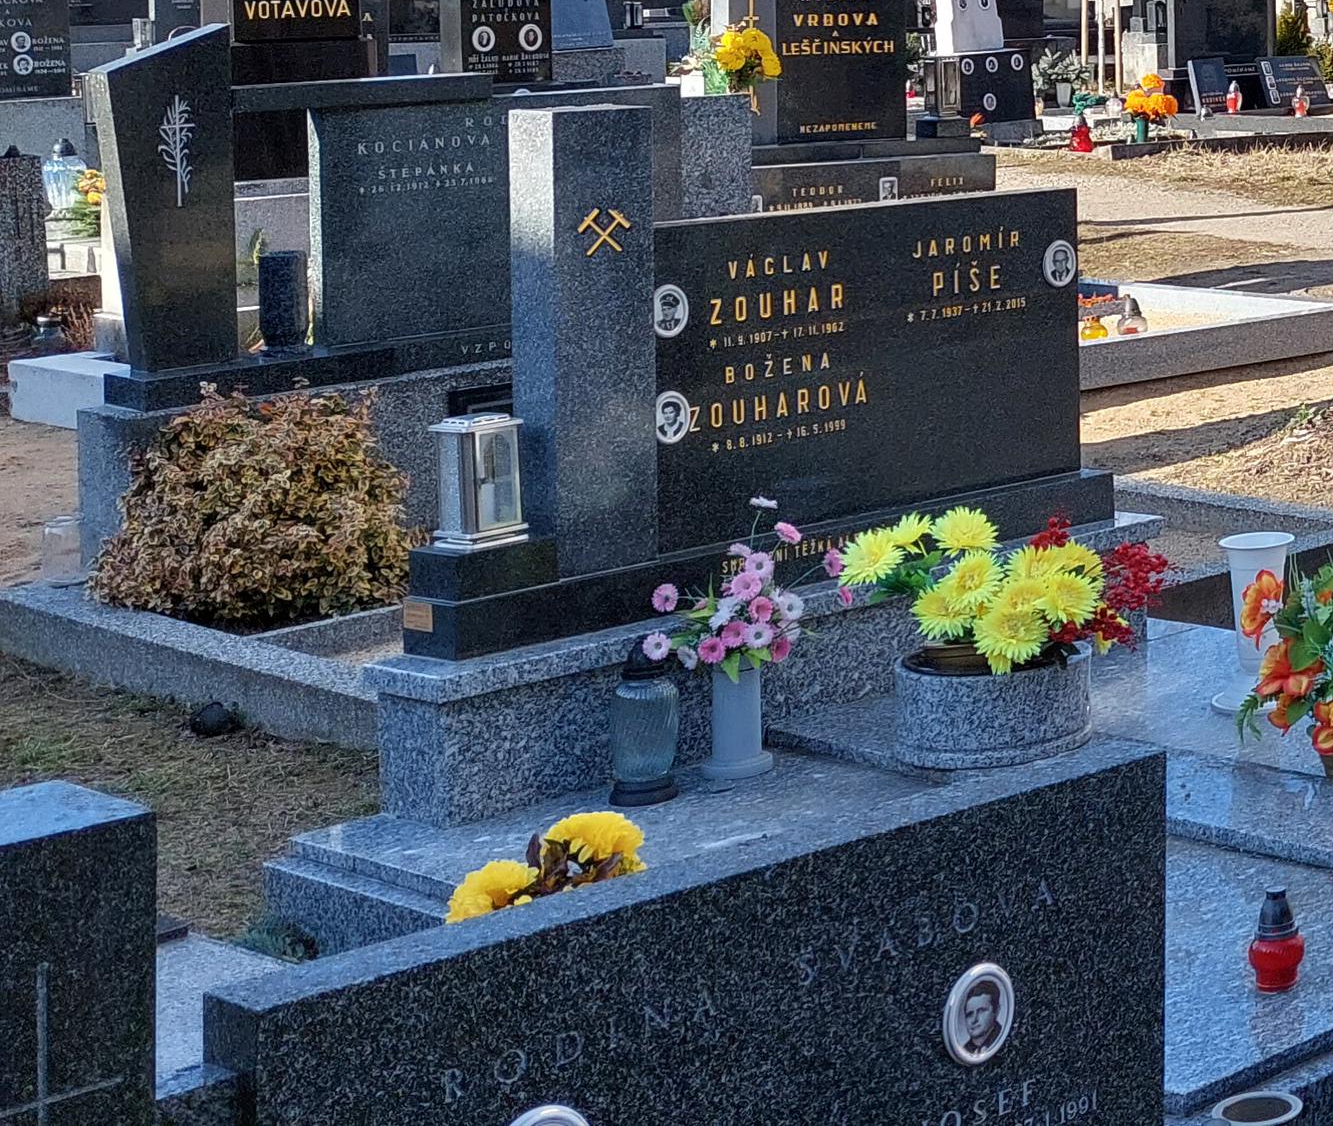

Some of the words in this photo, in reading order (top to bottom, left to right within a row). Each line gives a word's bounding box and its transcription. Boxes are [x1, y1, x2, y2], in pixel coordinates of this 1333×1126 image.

[793, 13, 878, 27] VRBOVA
[782, 36, 895, 55] LEŠČINSKÝCH
[912, 226, 1020, 258] JAROMÍR
[728, 250, 829, 279] VÁCLAV
[932, 260, 1001, 297] PÍŠE
[710, 283, 844, 325] ZOUHAR
[725, 352, 830, 384] BOŽENA
[689, 371, 868, 432] ZOUHAROVÁ
